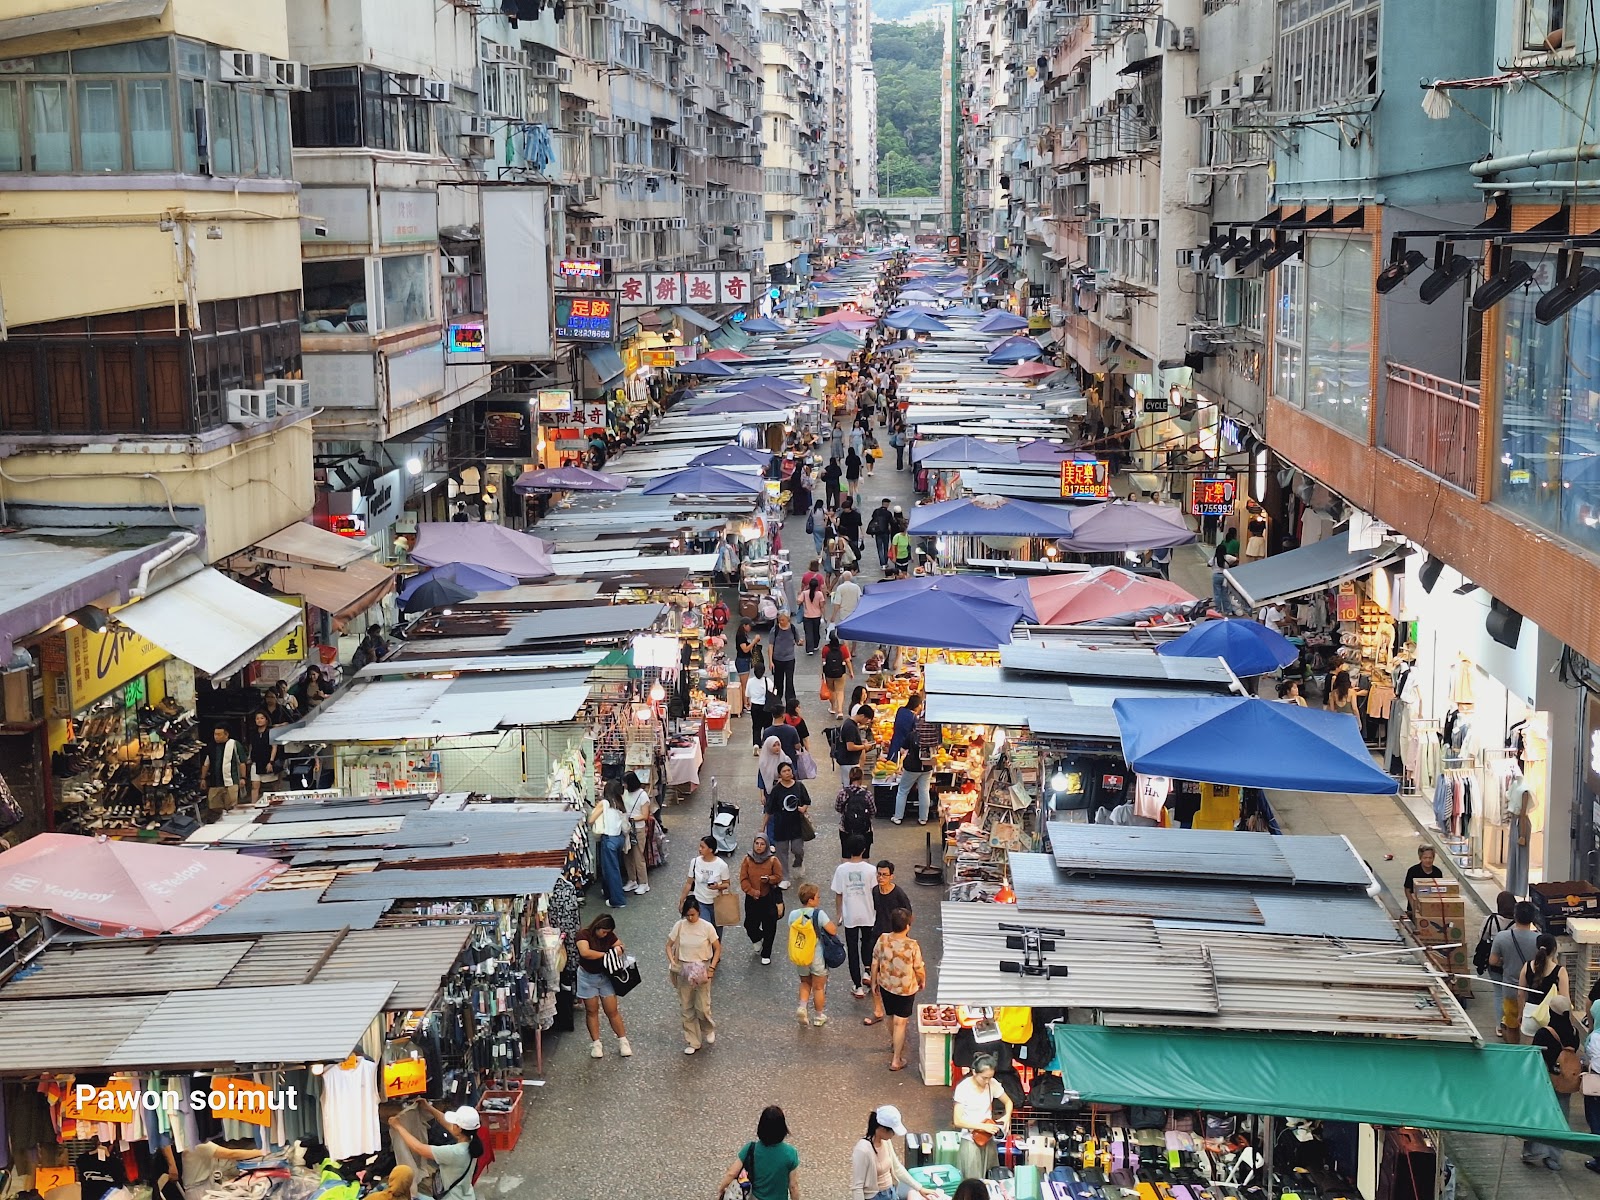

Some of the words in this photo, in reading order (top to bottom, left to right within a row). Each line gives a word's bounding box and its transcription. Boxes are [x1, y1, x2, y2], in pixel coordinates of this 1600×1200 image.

[571, 299, 610, 317] 足跡
[1145, 401, 1168, 410] CYCLE
[1064, 485, 1105, 494] 91755993
[1194, 504, 1233, 514] 91755993
[1340, 608, 1356, 619] 10
[163, 860, 207, 888] Yedpay
[43, 883, 115, 903] Yedpay
